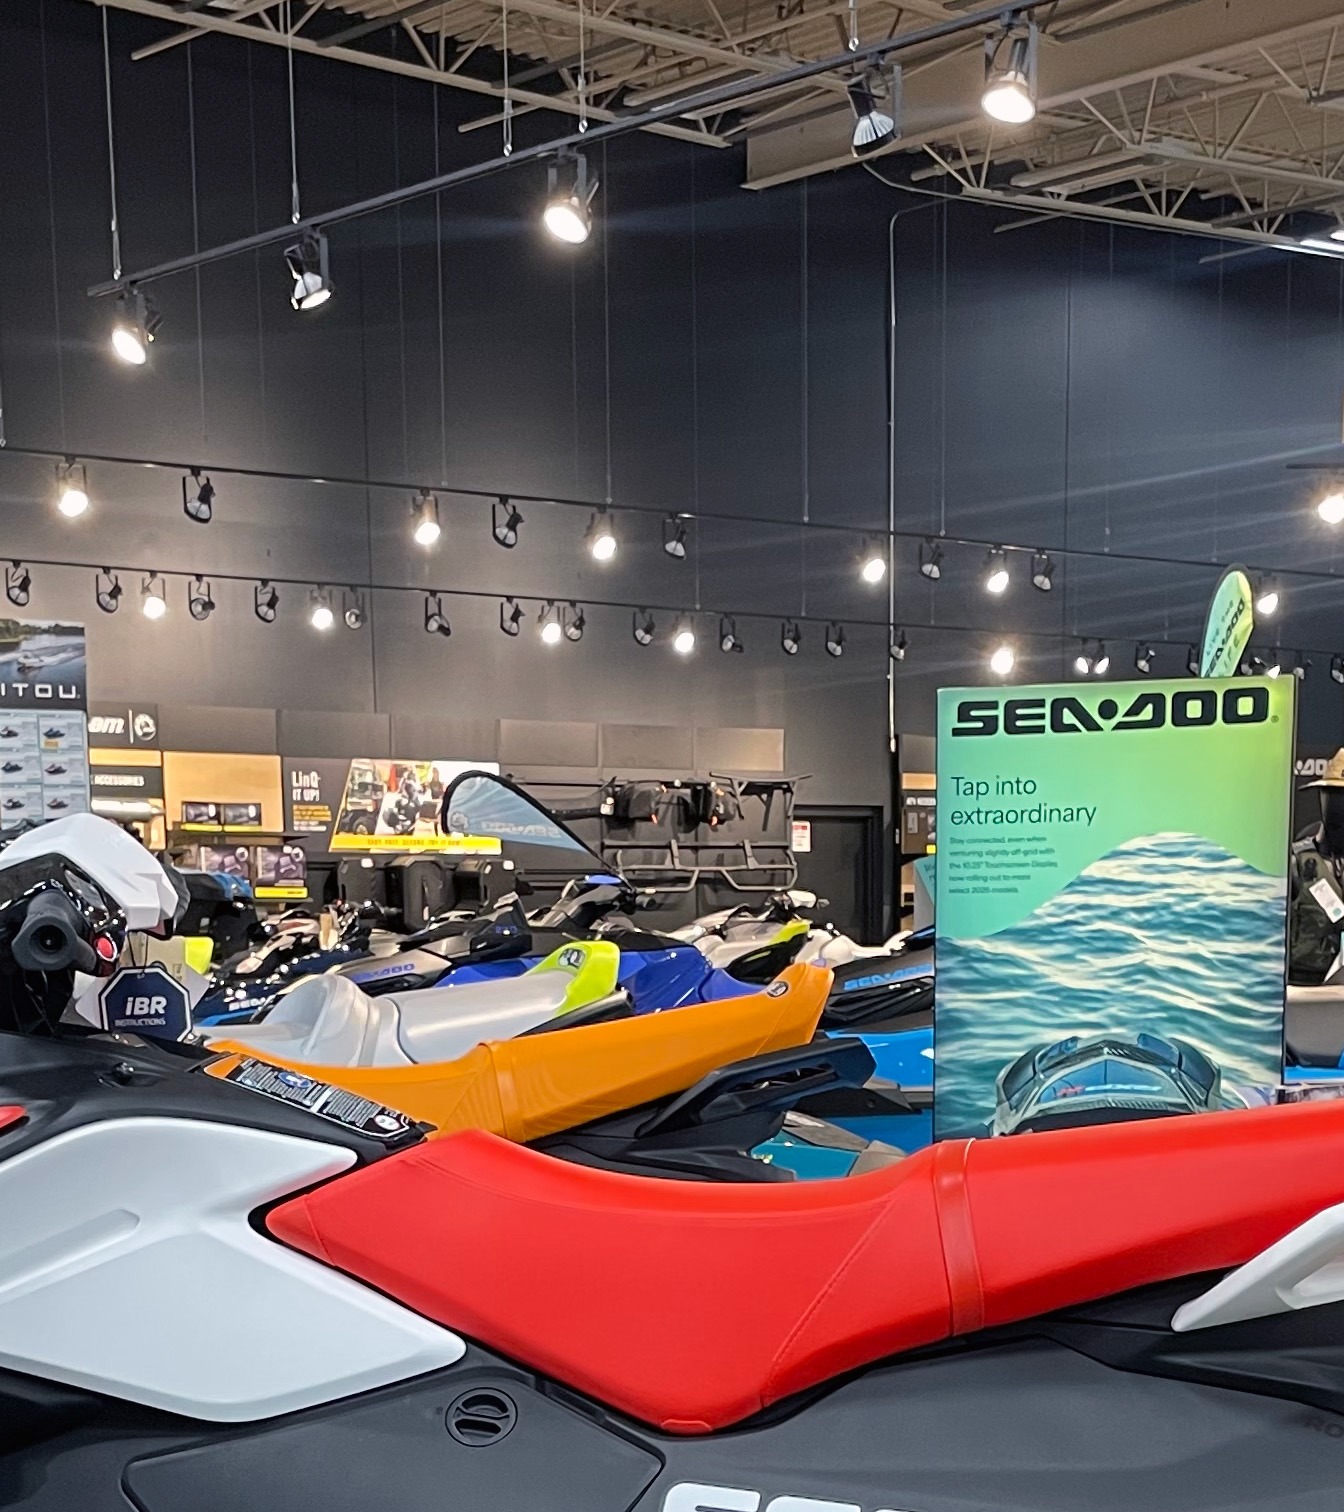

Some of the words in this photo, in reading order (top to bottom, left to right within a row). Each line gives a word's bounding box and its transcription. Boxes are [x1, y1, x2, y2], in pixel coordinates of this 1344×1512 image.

[951, 776, 989, 801] Tap
[996, 775, 1037, 796] into
[951, 802, 1097, 827] extraordinary
[125, 996, 167, 1016] iBR
